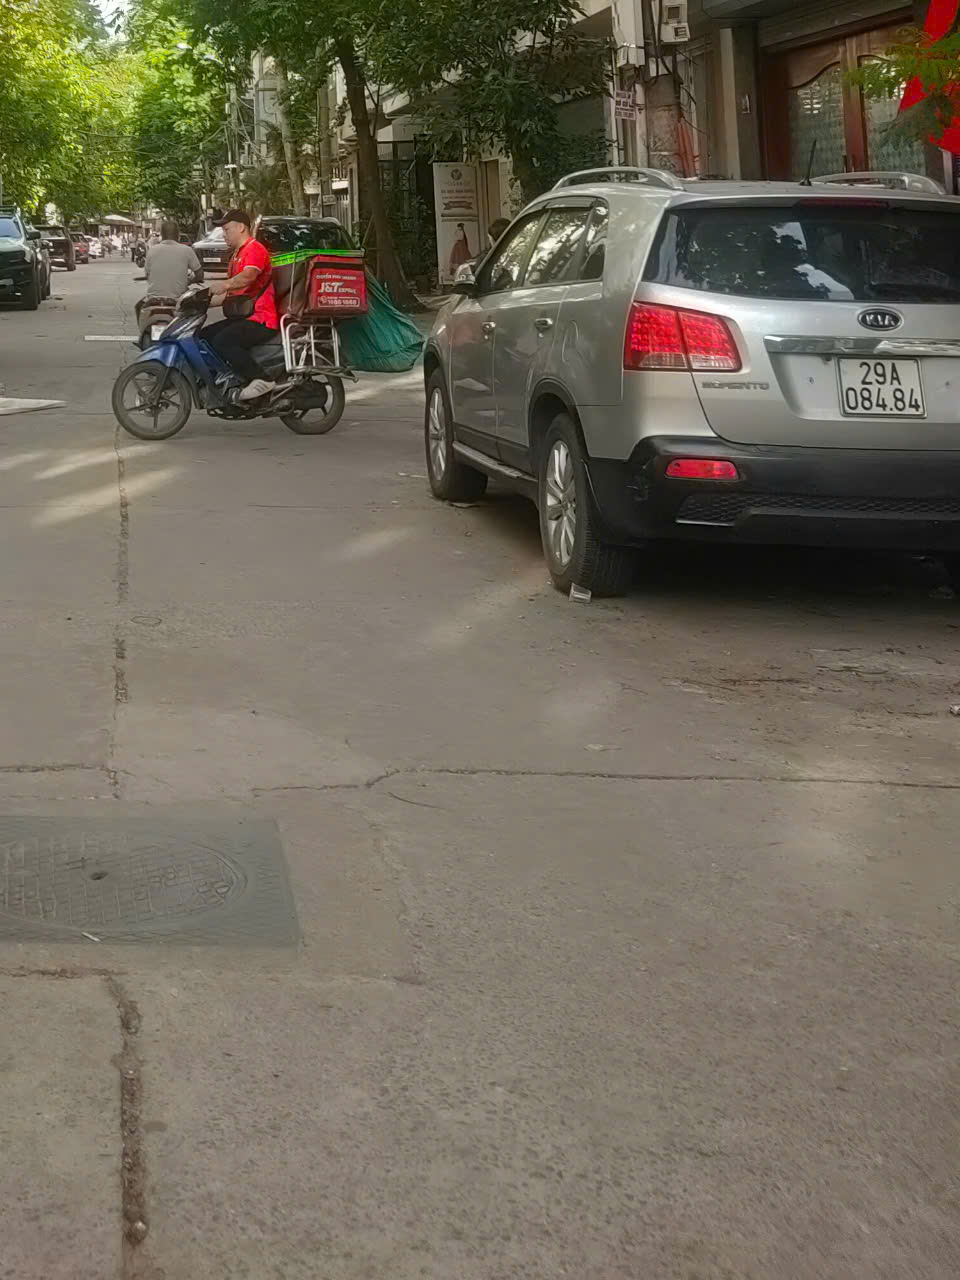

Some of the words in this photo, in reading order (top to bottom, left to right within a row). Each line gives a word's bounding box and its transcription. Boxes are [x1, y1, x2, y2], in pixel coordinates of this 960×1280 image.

[318, 281, 344, 294] J&T
[864, 313, 896, 327] KIA
[859, 361, 902, 387] 29A
[845, 386, 922, 412] 084.84
